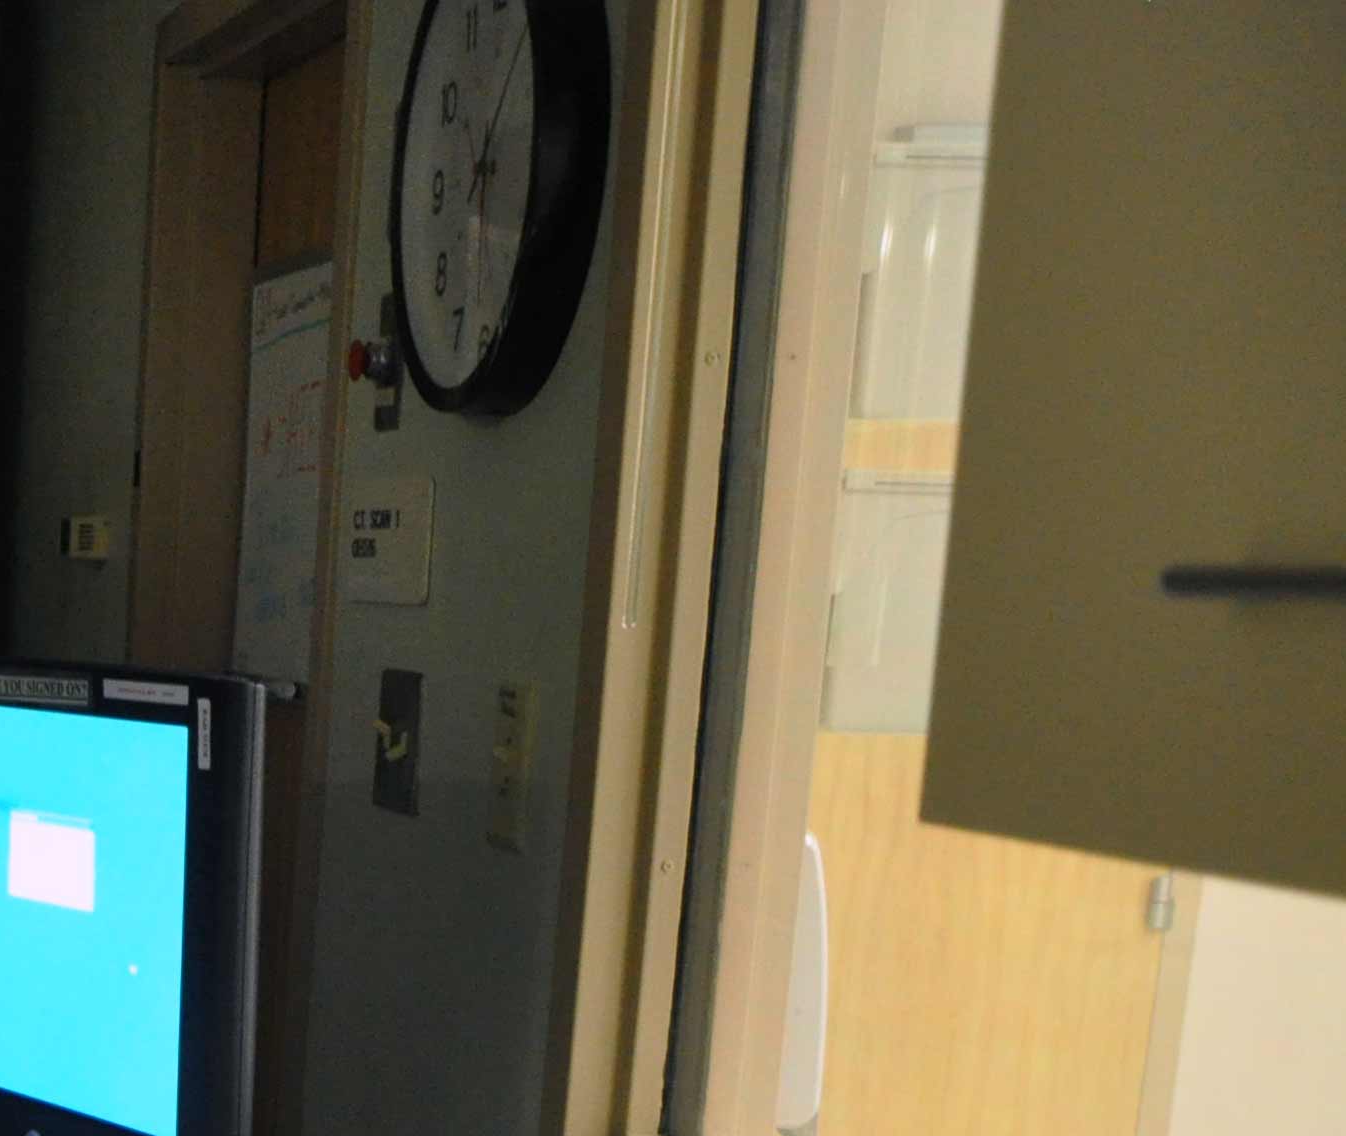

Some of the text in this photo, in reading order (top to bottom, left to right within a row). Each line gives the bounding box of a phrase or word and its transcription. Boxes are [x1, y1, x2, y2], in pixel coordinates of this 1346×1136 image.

[466, 5, 477, 53] 11
[441, 80, 459, 127] 10
[431, 169, 445, 216] 9
[434, 252, 448, 297] 8
[452, 307, 465, 353] 7
[353, 509, 366, 530] CT
[369, 508, 391, 530] SCAN
[2, 679, 23, 695] YOU
[25, 679, 63, 697] SIGNED
